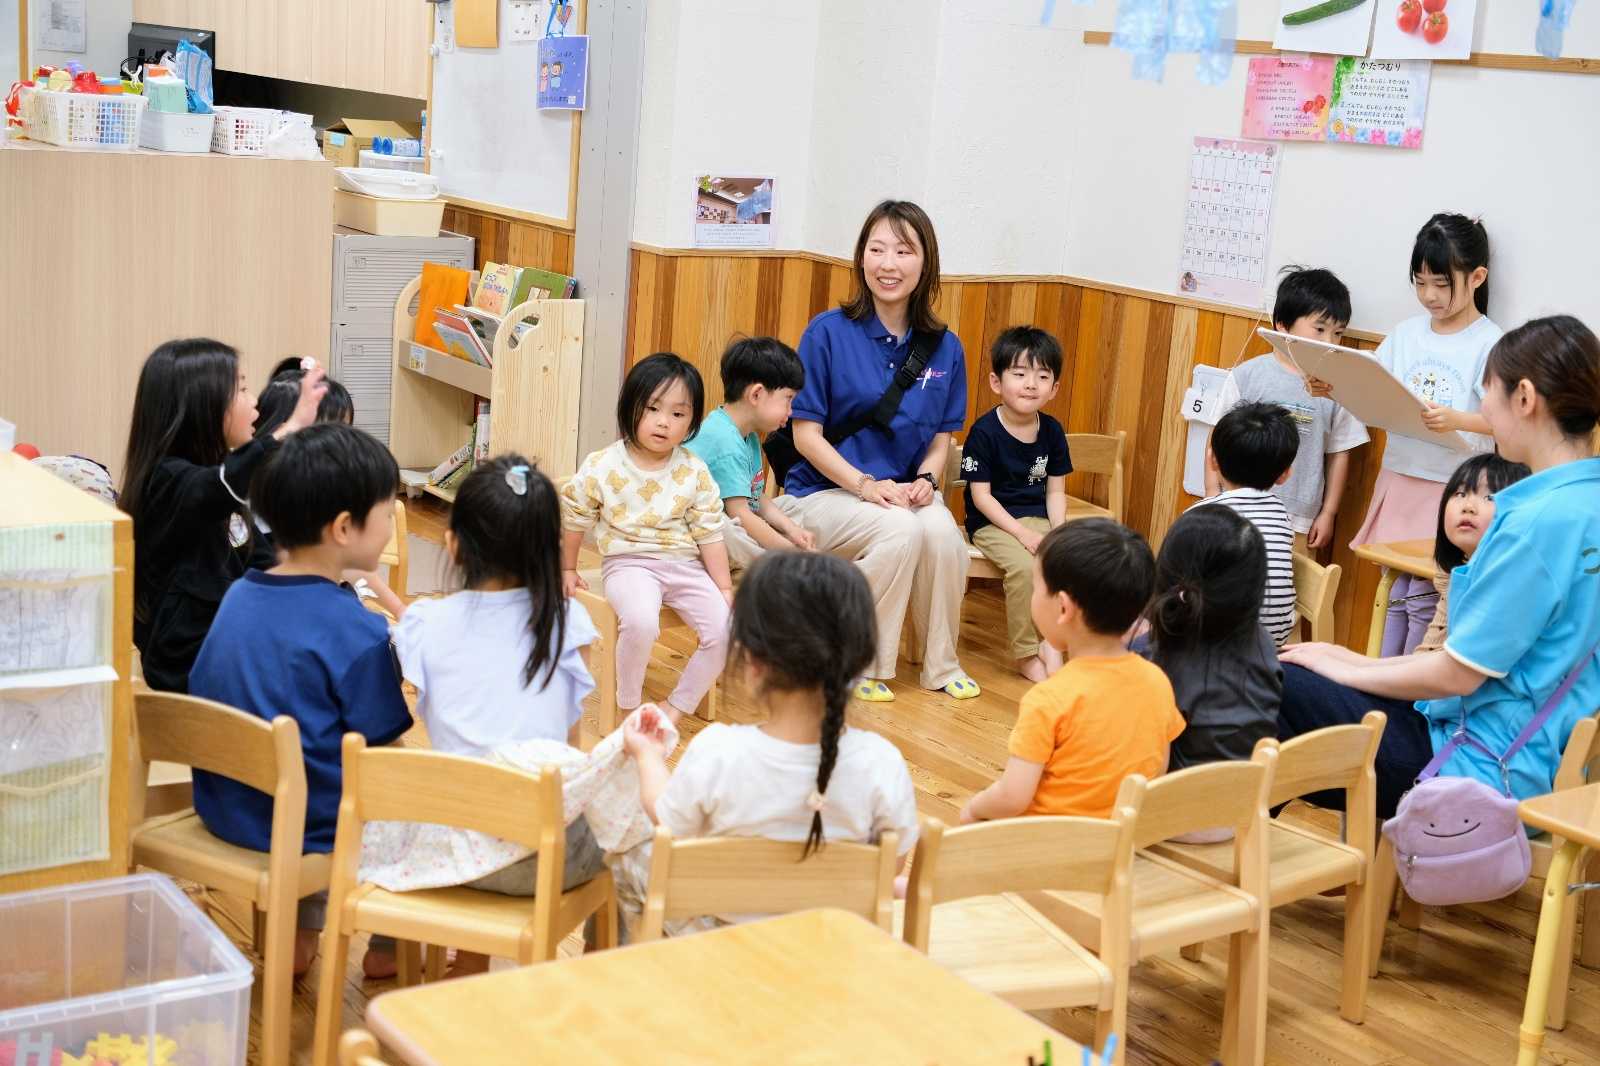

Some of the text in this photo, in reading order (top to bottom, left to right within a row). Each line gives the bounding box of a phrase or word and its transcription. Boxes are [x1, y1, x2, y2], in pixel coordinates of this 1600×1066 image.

[1360, 61, 1401, 72] かたつむり
[1192, 400, 1203, 413] 5
